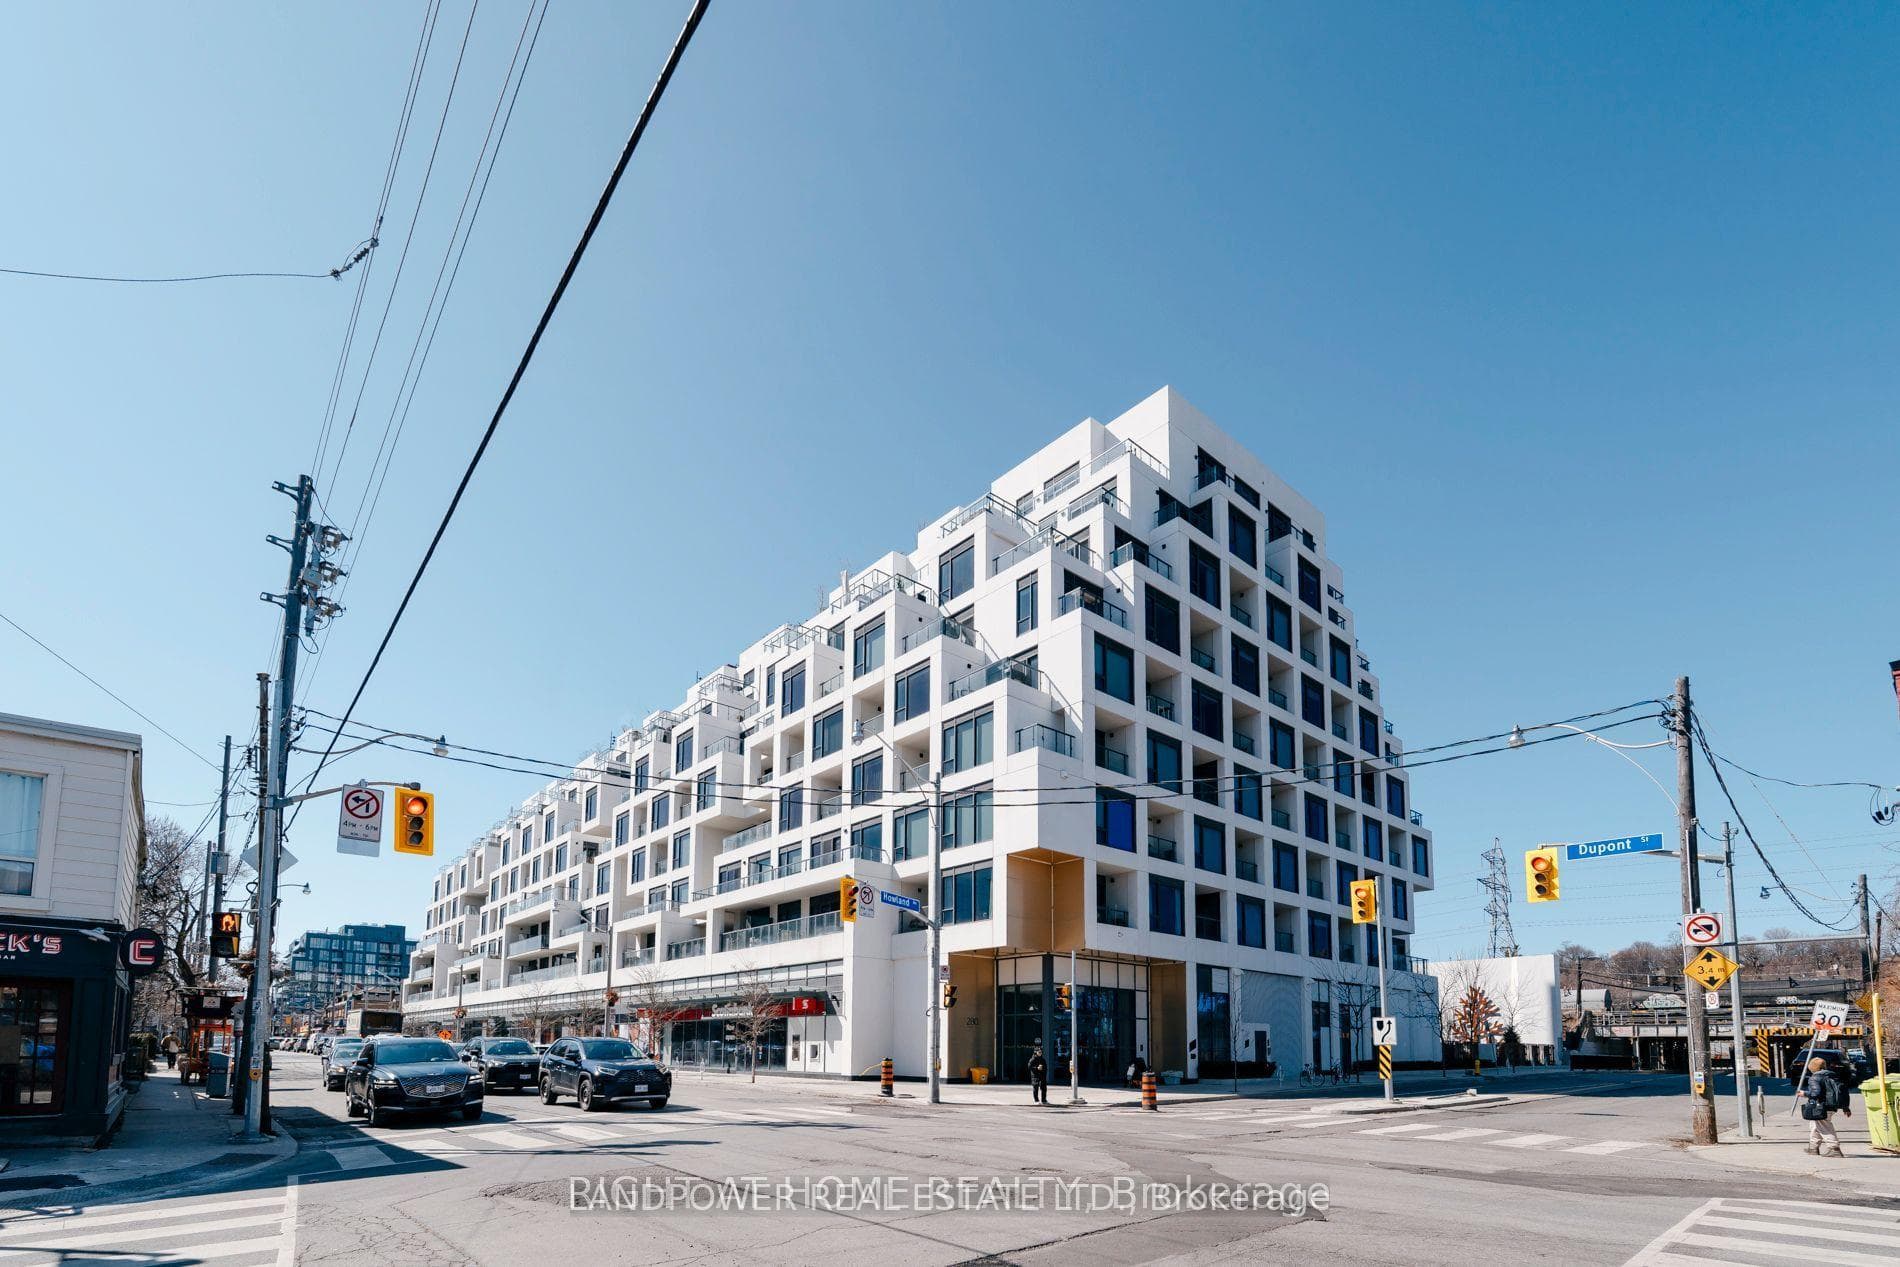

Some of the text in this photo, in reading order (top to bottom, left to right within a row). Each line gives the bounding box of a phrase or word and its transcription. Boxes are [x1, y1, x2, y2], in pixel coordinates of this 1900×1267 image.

[1578, 839, 1631, 855] Dupont
[883, 891, 910, 906] Howland
[129, 939, 155, 965] C
[1697, 965, 1714, 975] 3.4
[1814, 1012, 1840, 1028] 30
